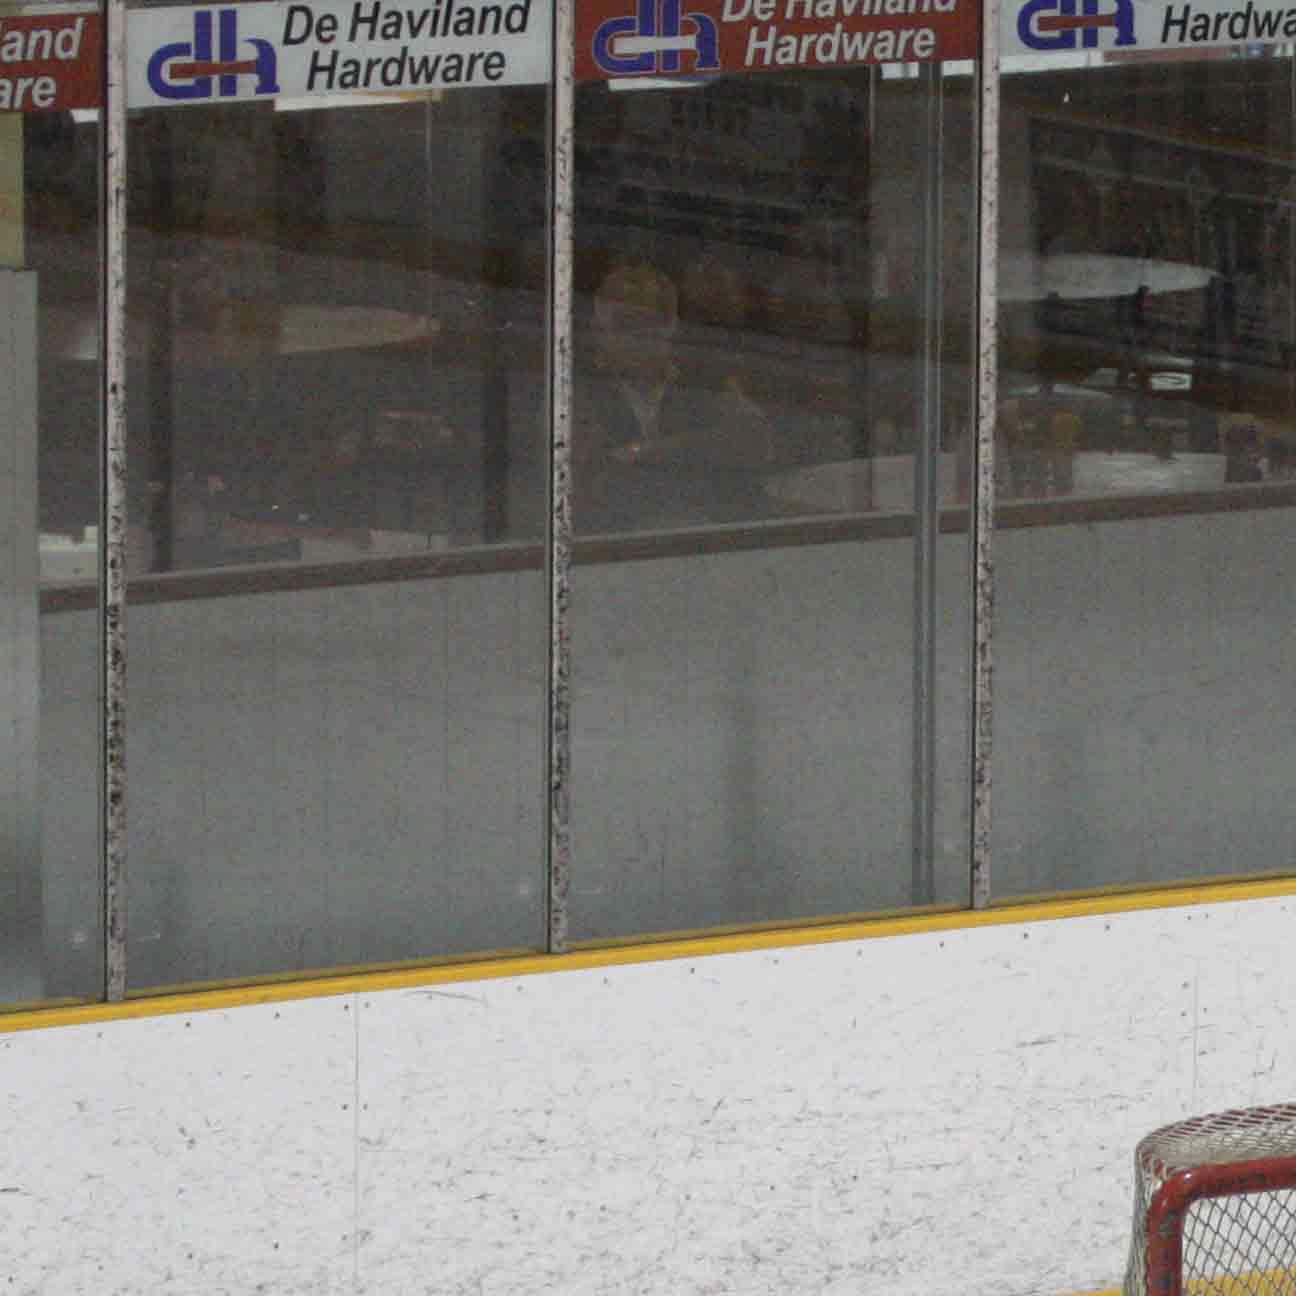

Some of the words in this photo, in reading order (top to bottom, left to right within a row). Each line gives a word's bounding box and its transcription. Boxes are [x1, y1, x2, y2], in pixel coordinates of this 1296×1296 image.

[283, 4, 338, 45] De
[348, 0, 531, 42] Haviland
[744, 22, 937, 66] Hardware
[306, 46, 506, 91] Hardware
